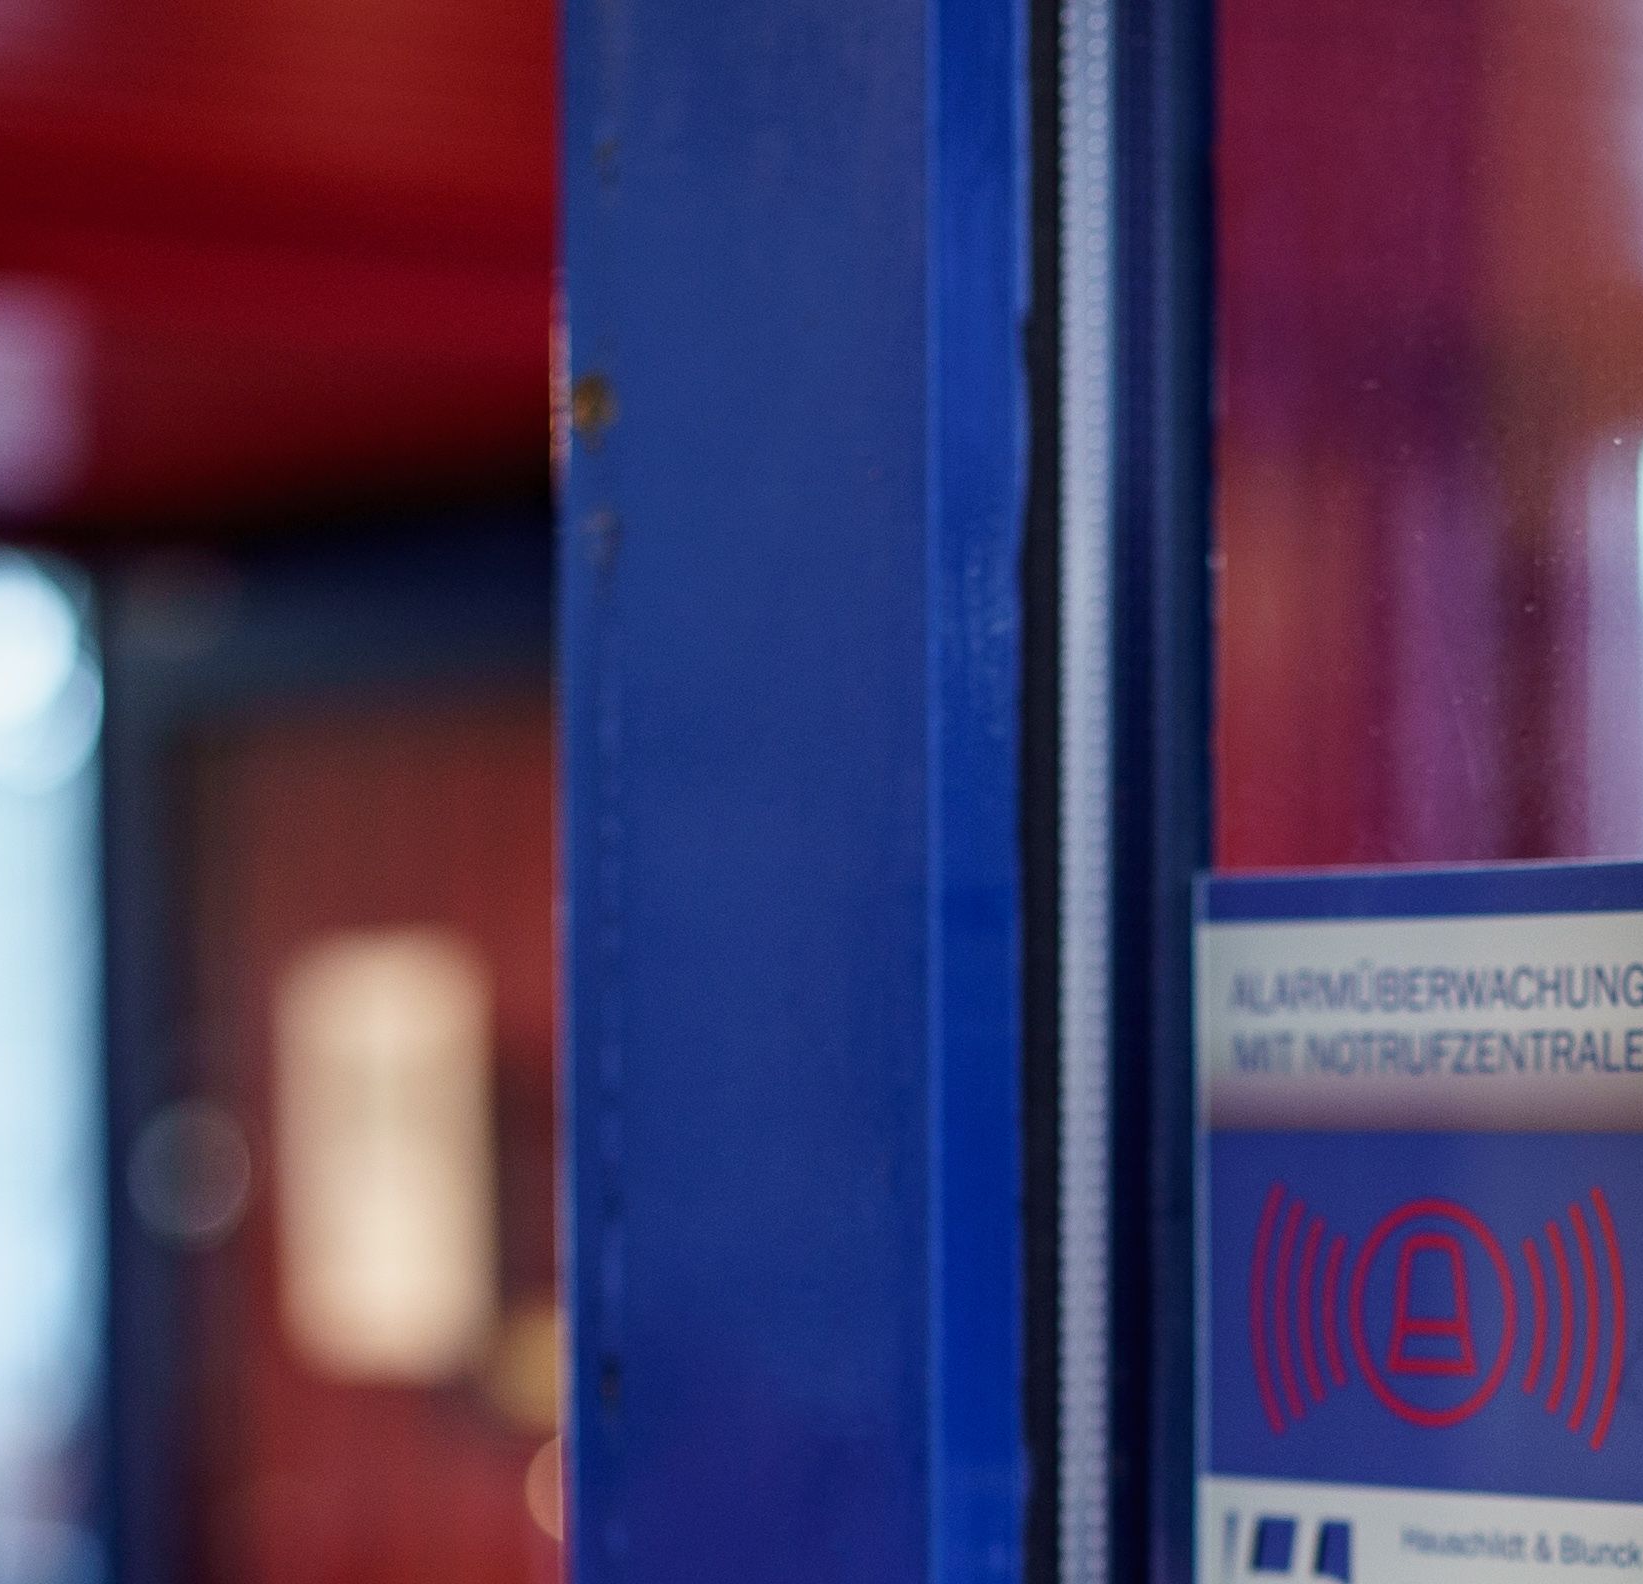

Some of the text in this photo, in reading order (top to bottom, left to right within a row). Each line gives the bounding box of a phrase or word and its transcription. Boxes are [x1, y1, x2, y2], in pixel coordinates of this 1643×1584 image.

[1230, 1029, 1294, 1075] MIT
[1533, 1531, 1553, 1564] &
[1559, 1532, 1643, 1569] Blunck
